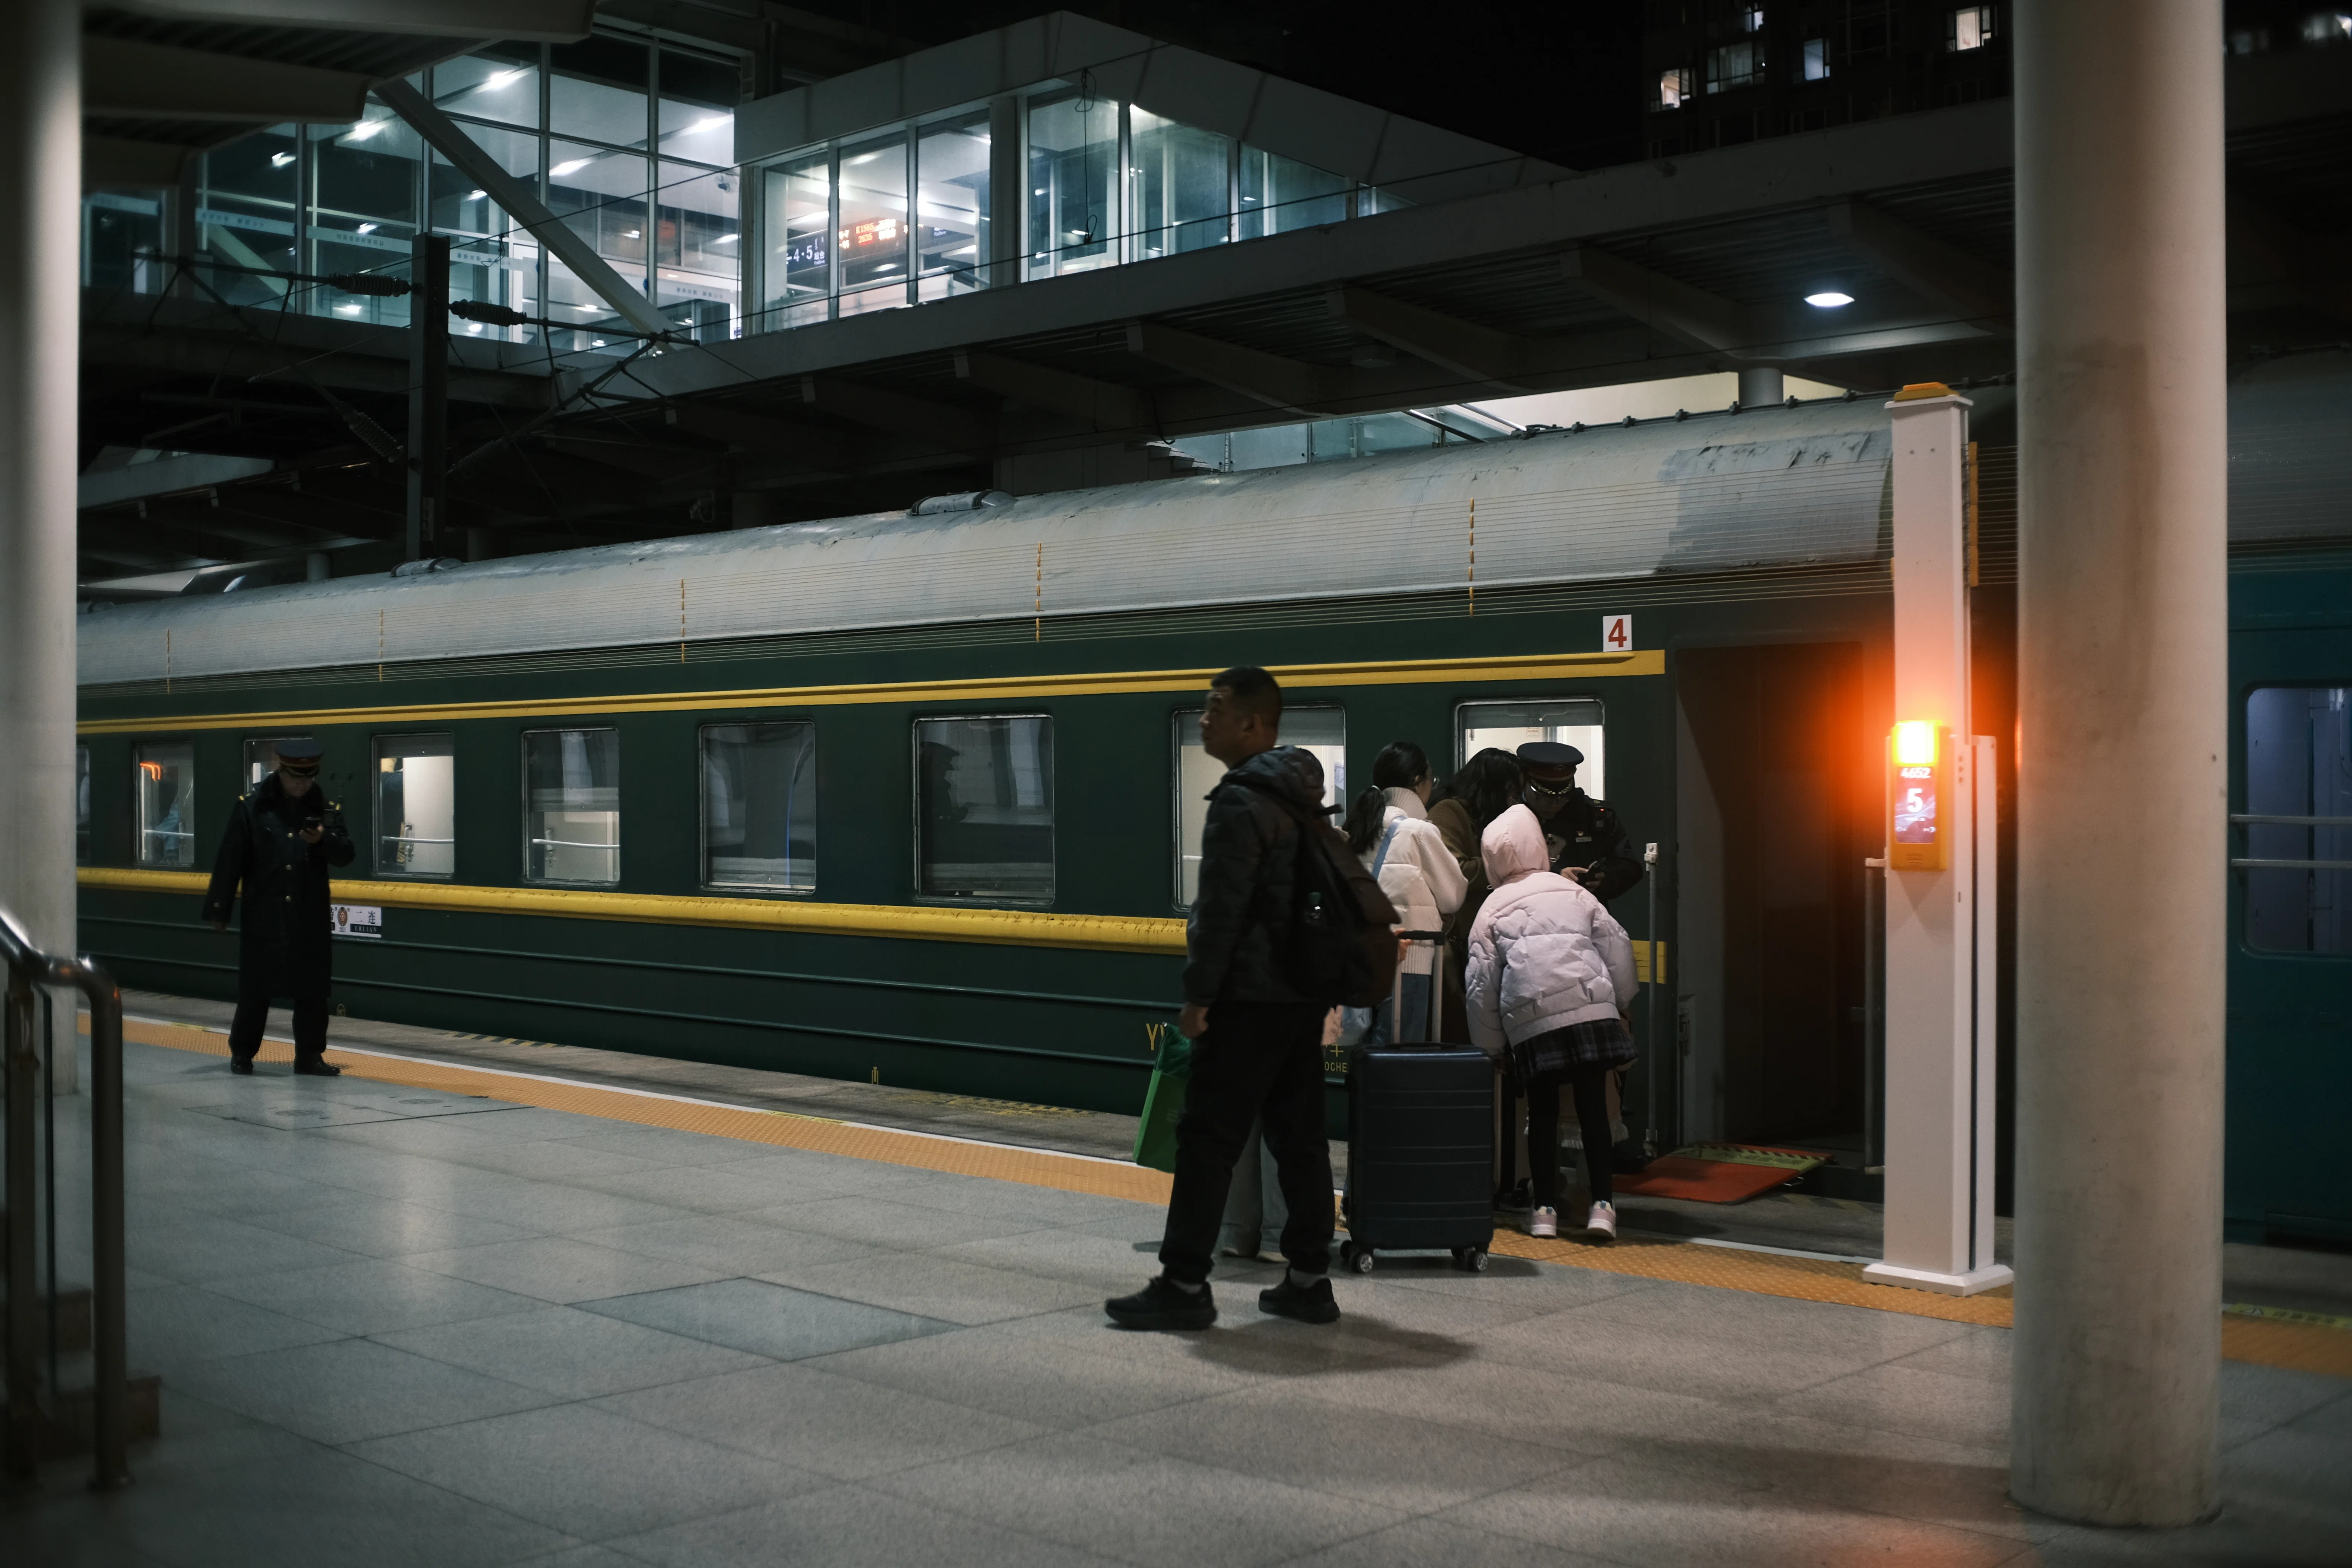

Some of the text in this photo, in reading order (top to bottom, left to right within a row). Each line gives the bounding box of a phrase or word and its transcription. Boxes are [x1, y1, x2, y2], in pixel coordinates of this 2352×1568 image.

[1608, 618, 1627, 648] 4
[1900, 767, 1931, 778] 4652
[1906, 788, 1923, 813] 5
[355, 911, 375, 924] 二连
